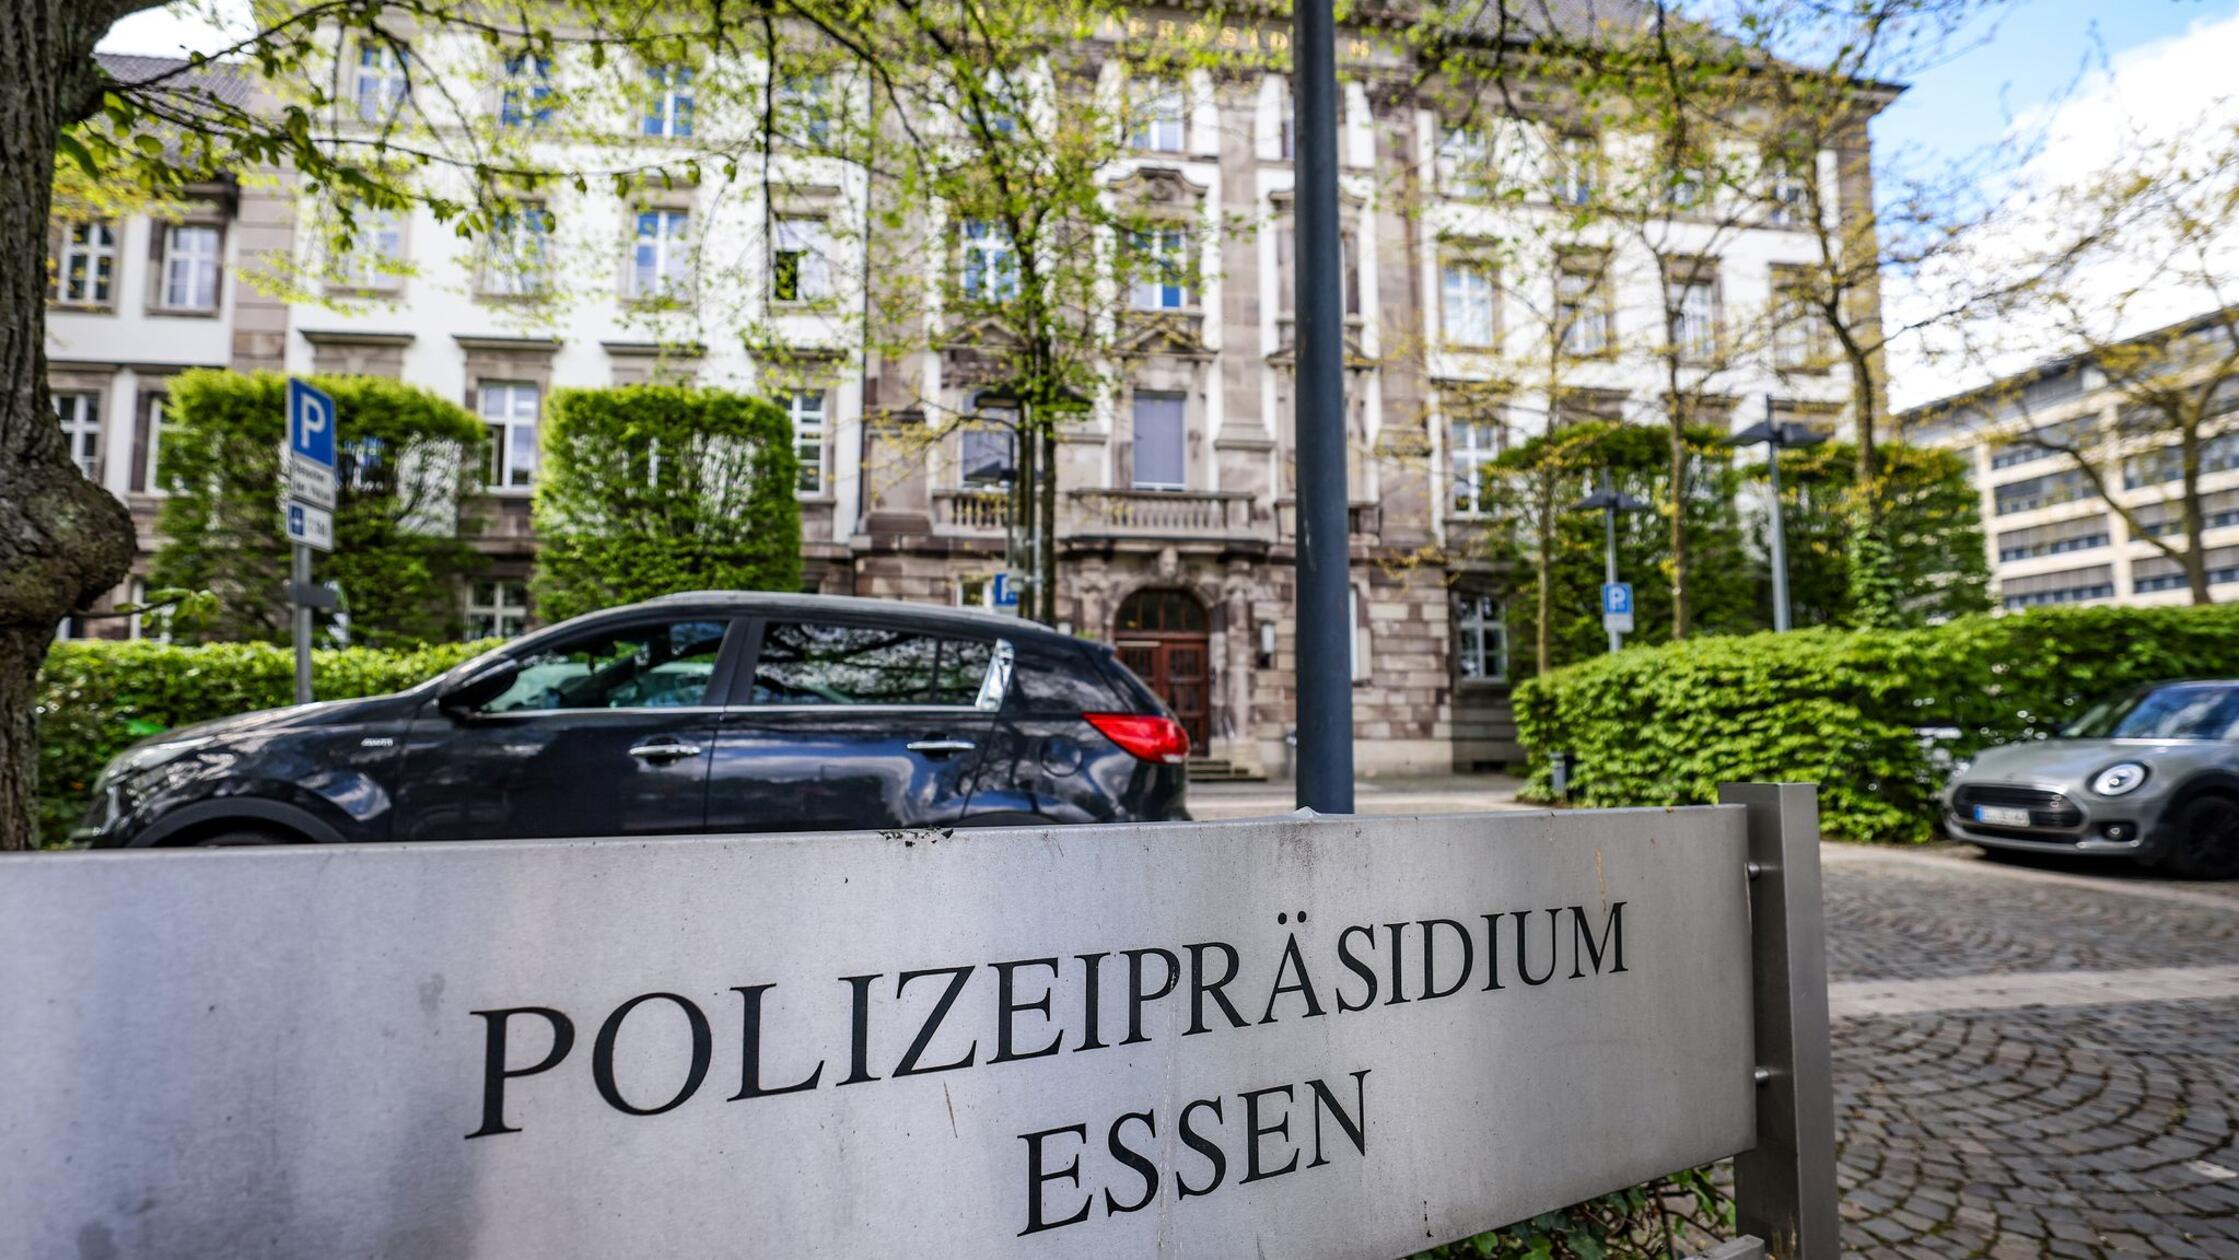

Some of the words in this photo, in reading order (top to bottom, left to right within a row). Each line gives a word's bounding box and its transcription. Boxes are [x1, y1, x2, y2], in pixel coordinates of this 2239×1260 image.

[301, 393, 327, 449] P
[463, 901, 1630, 1141] POLIZEIPRÄSIDIUM
[1016, 1069, 1372, 1239] ESSEN
